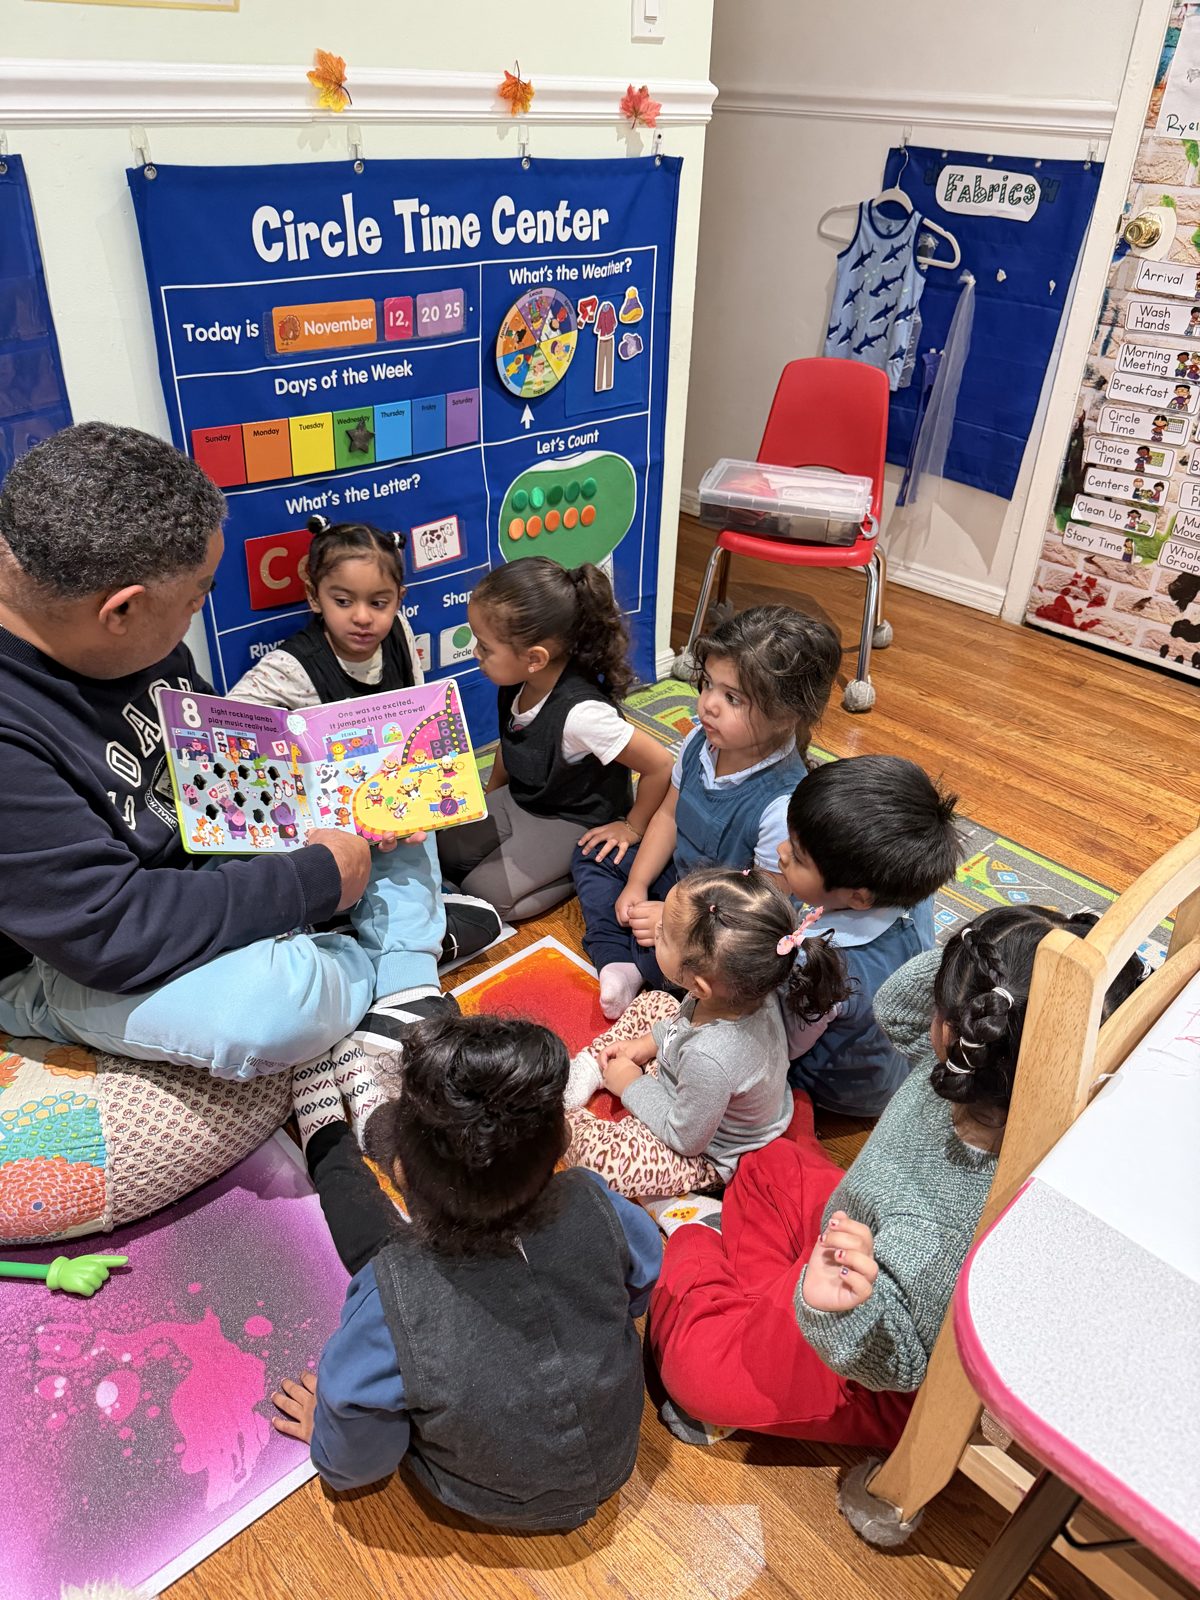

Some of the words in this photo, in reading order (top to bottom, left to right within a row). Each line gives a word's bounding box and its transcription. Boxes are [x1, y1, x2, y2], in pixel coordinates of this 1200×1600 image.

[252, 193, 383, 263] Circle
[393, 198, 481, 253] Time
[491, 195, 609, 246] Center
[509, 267, 553, 285] What's
[556, 265, 579, 281] the
[582, 257, 633, 279] Weather?
[1141, 268, 1185, 285] Arrival
[1140, 305, 1171, 319] Wash
[182, 323, 242, 345] Today
[245, 319, 260, 338] is
[303, 315, 374, 337] November
[389, 310, 410, 328] 12,
[1135, 317, 1171, 332] Hands
[1125, 345, 1172, 363] Morning
[1122, 357, 1168, 375] Meeting
[275, 378, 317, 397] Days
[321, 370, 339, 389] of
[343, 368, 368, 385] the
[371, 359, 413, 383] Week
[1112, 379, 1169, 399] Breakfast
[421, 403, 437, 412] Friday
[452, 396, 473, 406] Saturday
[337, 415, 370, 425] Wednesday
[381, 408, 405, 418] Thursday
[1108, 409, 1141, 424] Circle
[253, 427, 280, 438] Monday
[299, 421, 325, 431] Tuesday
[1110, 421, 1135, 435] Time
[205, 433, 231, 444] Sunday
[536, 437, 565, 455] Let's
[567, 430, 599, 449] Count
[1095, 439, 1130, 455] Choice
[1099, 451, 1123, 466] Time
[1088, 475, 1130, 493] Centers
[286, 491, 340, 516] What's
[344, 485, 370, 505] the
[373, 473, 421, 499] Letter?
[1078, 501, 1105, 517] Clean
[1108, 506, 1122, 522] Up
[1066, 527, 1095, 547] Story
[1099, 536, 1123, 552] Time
[1170, 543, 1200, 563] Whole
[1166, 555, 1200, 574] Group
[452, 648, 472, 660] circle
[181, 697, 202, 728] 8
[210, 706, 228, 717] Eight
[229, 710, 254, 721] rocking
[254, 714, 273, 723] lambs
[337, 717, 367, 730] jumped
[368, 714, 383, 722] into
[384, 711, 397, 719] the
[398, 705, 426, 716] crowd!
[338, 711, 353, 719] One
[355, 708, 371, 716] was
[208, 717, 223, 726] play
[224, 719, 243, 728] music
[244, 722, 263, 732] really
